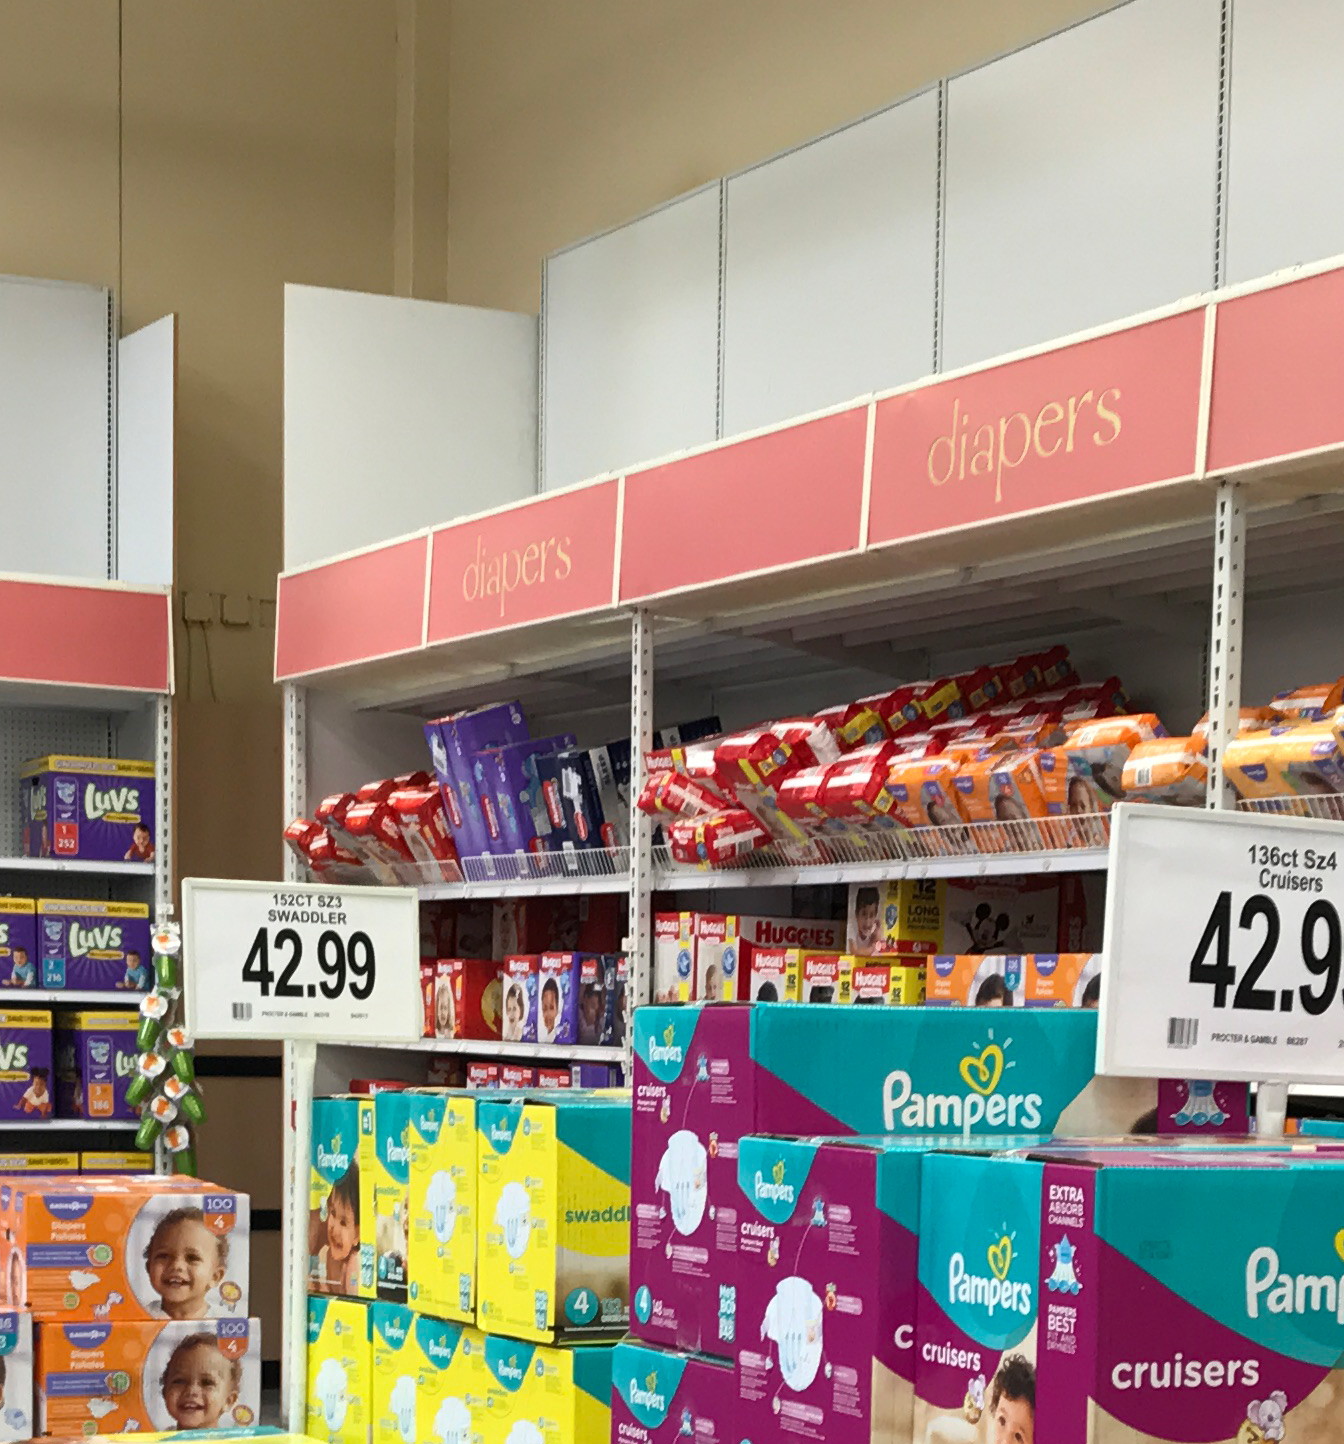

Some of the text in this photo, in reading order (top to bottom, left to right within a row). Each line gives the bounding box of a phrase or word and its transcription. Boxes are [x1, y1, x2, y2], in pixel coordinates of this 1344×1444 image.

[927, 379, 1123, 502] diapers
[461, 532, 572, 617] diapers
[84, 783, 140, 818] Luvs
[1248, 845, 1337, 871] 136ct Sz4
[1260, 869, 1323, 893] Cruisers
[273, 894, 342, 908] 152CT SZ3
[907, 905, 940, 916] LONG
[268, 910, 346, 925] SWADDLER
[69, 924, 122, 959] Luvs
[756, 921, 834, 947] HUGGIES
[243, 927, 375, 1000] 42.99
[806, 960, 836, 975] HUGGIES
[855, 971, 887, 987] HUGGIES
[1212, 1033, 1242, 1043] PROCTER
[1244, 1034, 1249, 1043] &
[1250, 1035, 1277, 1045] GAMBLE
[648, 1035, 682, 1065] Pampers
[638, 1083, 666, 1098] cruisers
[882, 1070, 1042, 1138] Pampers
[491, 1129, 511, 1142] Pampers
[318, 1152, 348, 1171] Pampers
[755, 1170, 794, 1204] Pampers
[1049, 1184, 1084, 1203] EXTRA
[207, 1199, 232, 1209] 100
[1049, 1201, 1084, 1217] ABSORB
[214, 1215, 225, 1228] 4
[565, 1207, 631, 1224] swaddl
[741, 1221, 775, 1239] cruisers
[949, 1252, 1031, 1317] Pampers
[574, 1291, 589, 1314] 4
[220, 1323, 245, 1334] 100
[922, 1340, 981, 1371] cruisers
[498, 1364, 523, 1379] Pampers
[1111, 1352, 1260, 1389] cruisers
